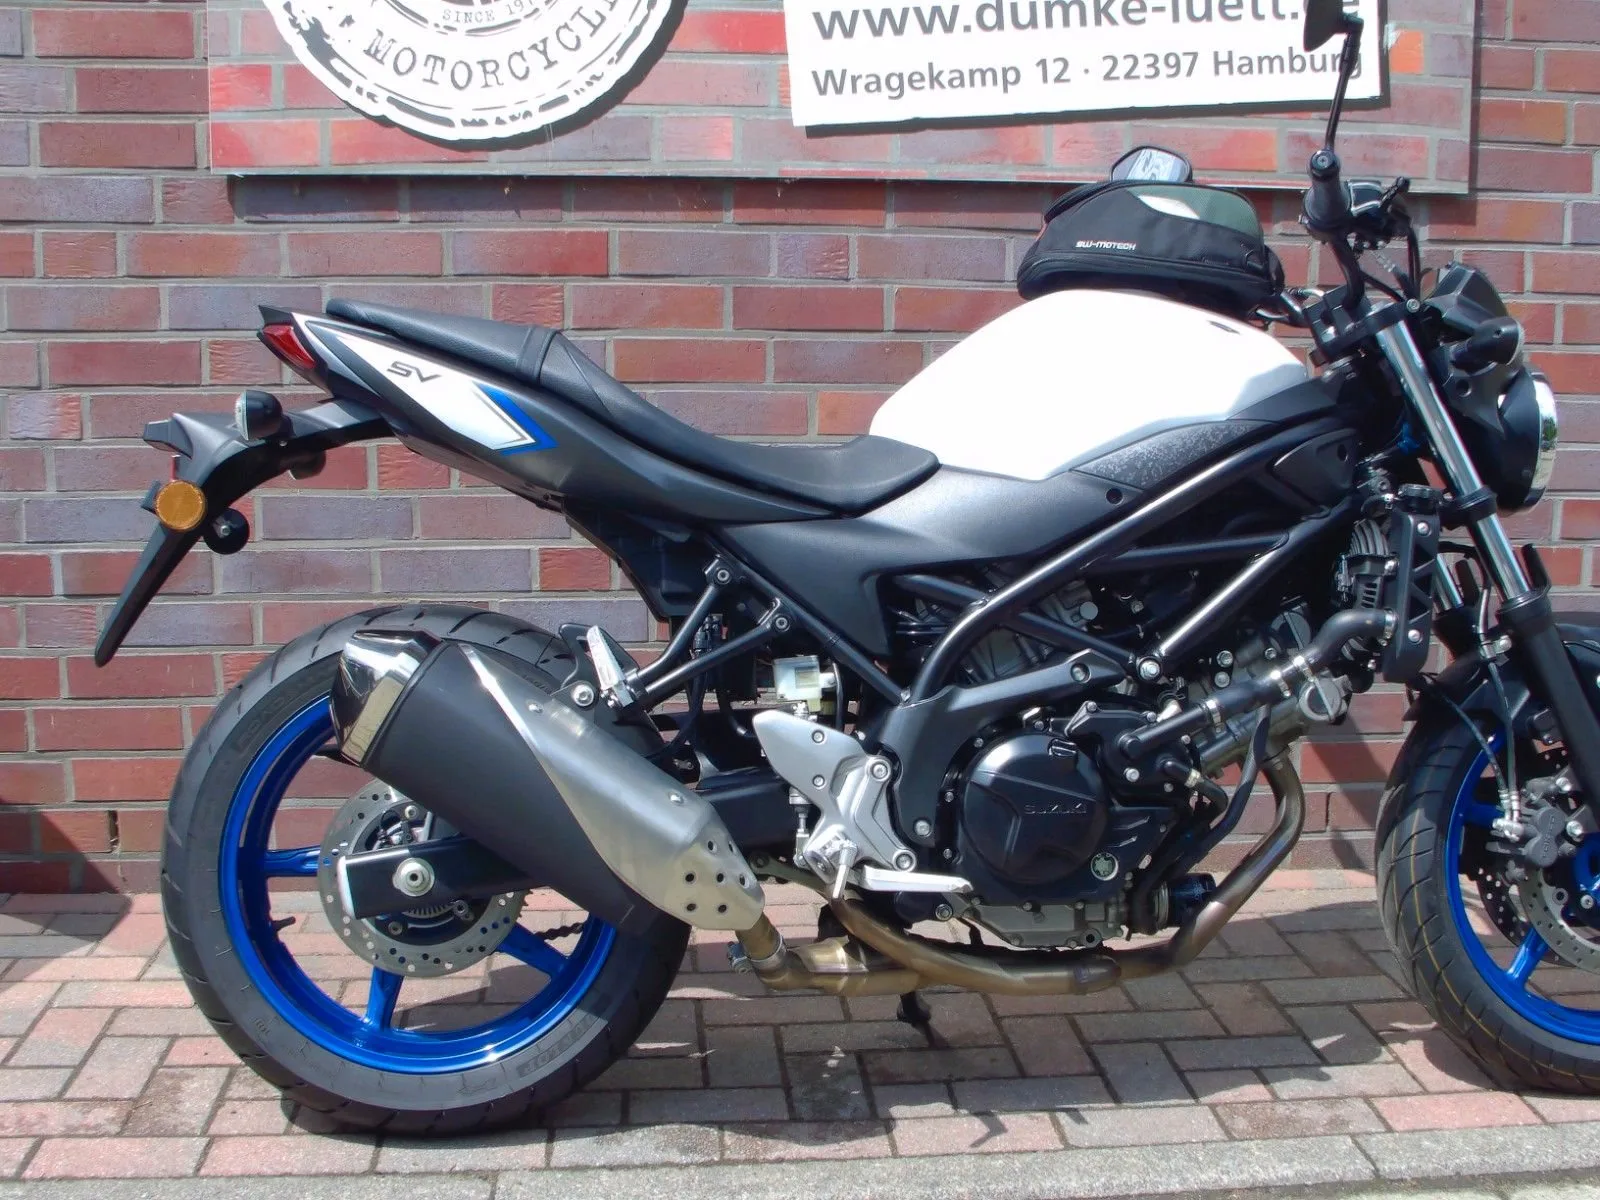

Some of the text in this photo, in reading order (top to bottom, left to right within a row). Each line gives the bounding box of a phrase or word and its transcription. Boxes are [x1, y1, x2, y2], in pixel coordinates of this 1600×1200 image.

[442, 0, 534, 24] SINCE 19
[812, 0, 1362, 40] www.dumke-luett.e
[363, 0, 618, 91] MOTORCYCL
[811, 62, 1021, 100] Wragekamp
[1035, 56, 1071, 84] 12
[1102, 51, 1199, 81] 22397
[387, 361, 443, 382] SV
